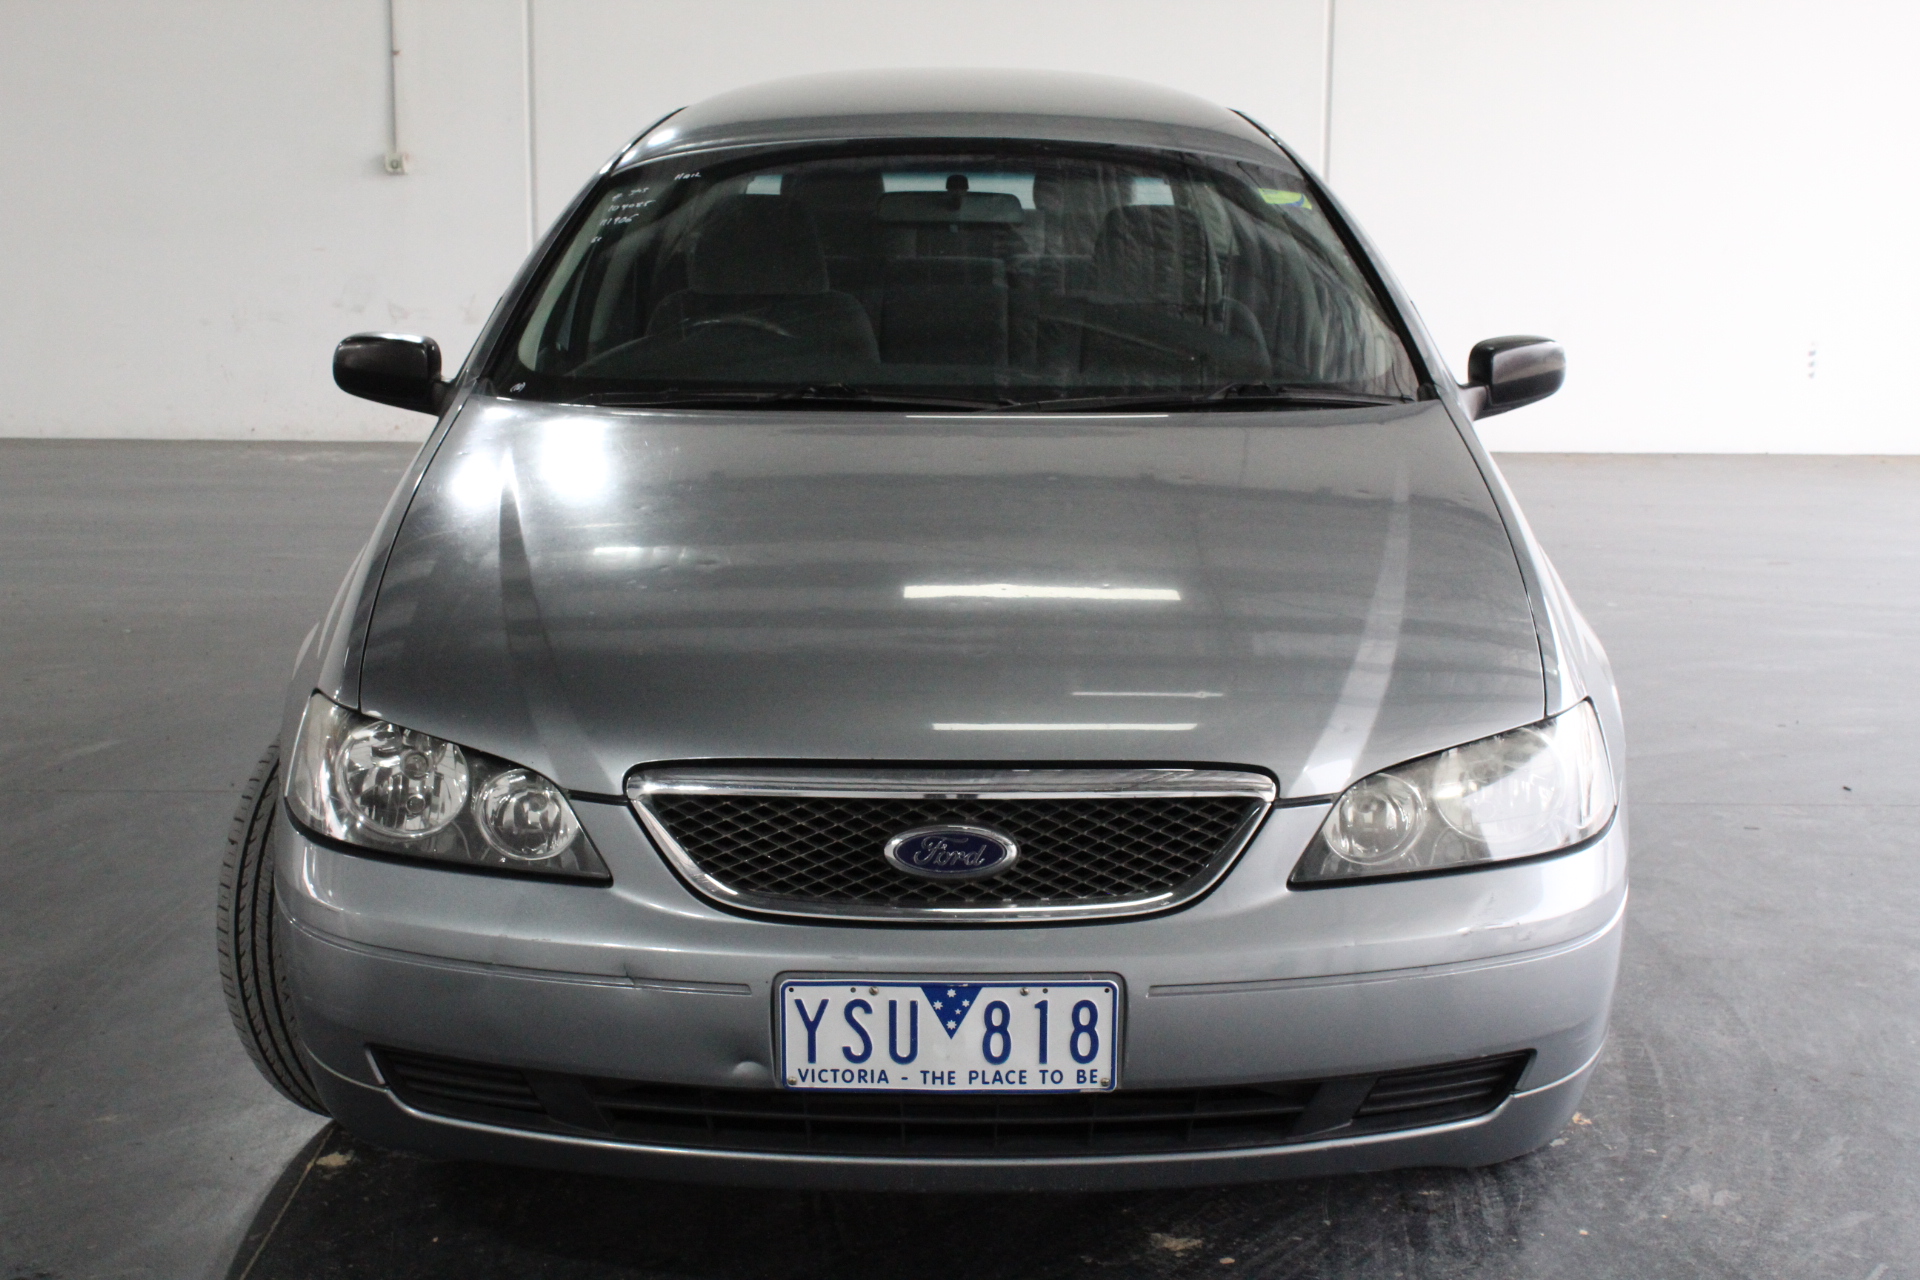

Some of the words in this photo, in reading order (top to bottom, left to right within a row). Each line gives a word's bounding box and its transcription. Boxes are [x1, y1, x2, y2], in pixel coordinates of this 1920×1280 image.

[913, 836, 987, 866] Ford
[794, 997, 919, 1065] YSU
[982, 999, 1100, 1065] 818
[797, 1068, 889, 1084] VICTORIA
[920, 1070, 956, 1085] THE
[968, 1069, 1028, 1085] PLACE
[1040, 1069, 1063, 1085] TO
[1076, 1068, 1099, 1084] BE
